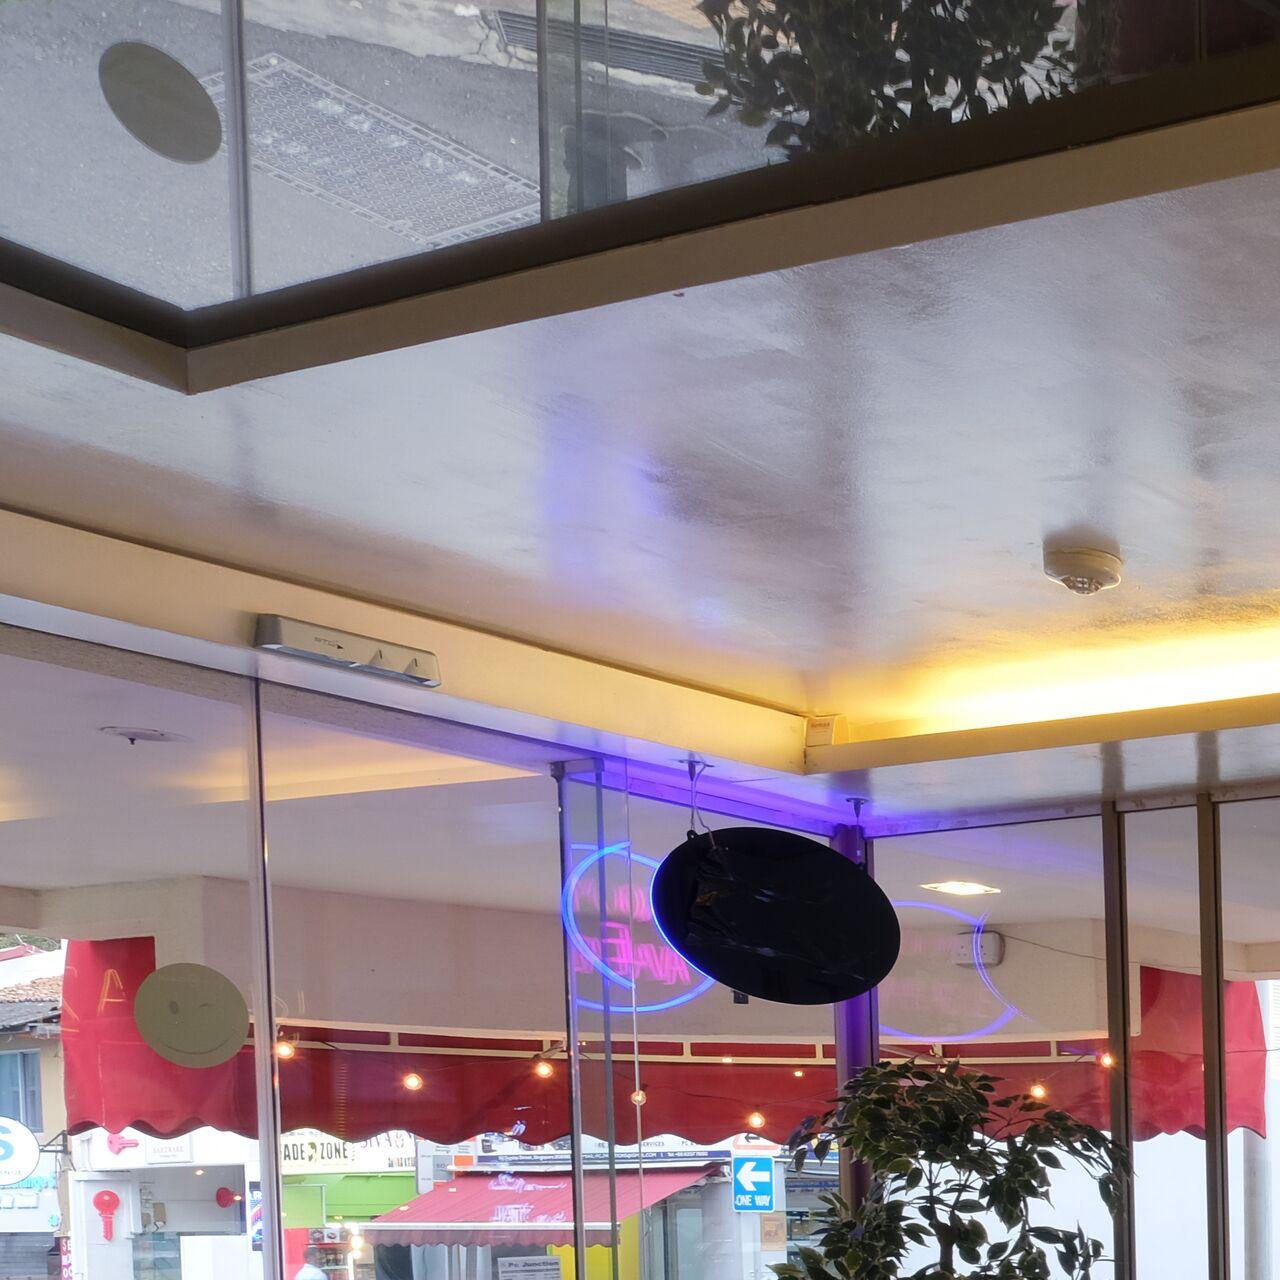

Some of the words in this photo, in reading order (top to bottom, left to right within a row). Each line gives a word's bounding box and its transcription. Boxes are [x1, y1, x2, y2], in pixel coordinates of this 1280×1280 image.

[281, 1143, 305, 1161] ADE
[320, 1142, 349, 1160] ZONE
[735, 1194, 752, 1207] ONE
[754, 1194, 772, 1207] WAY
